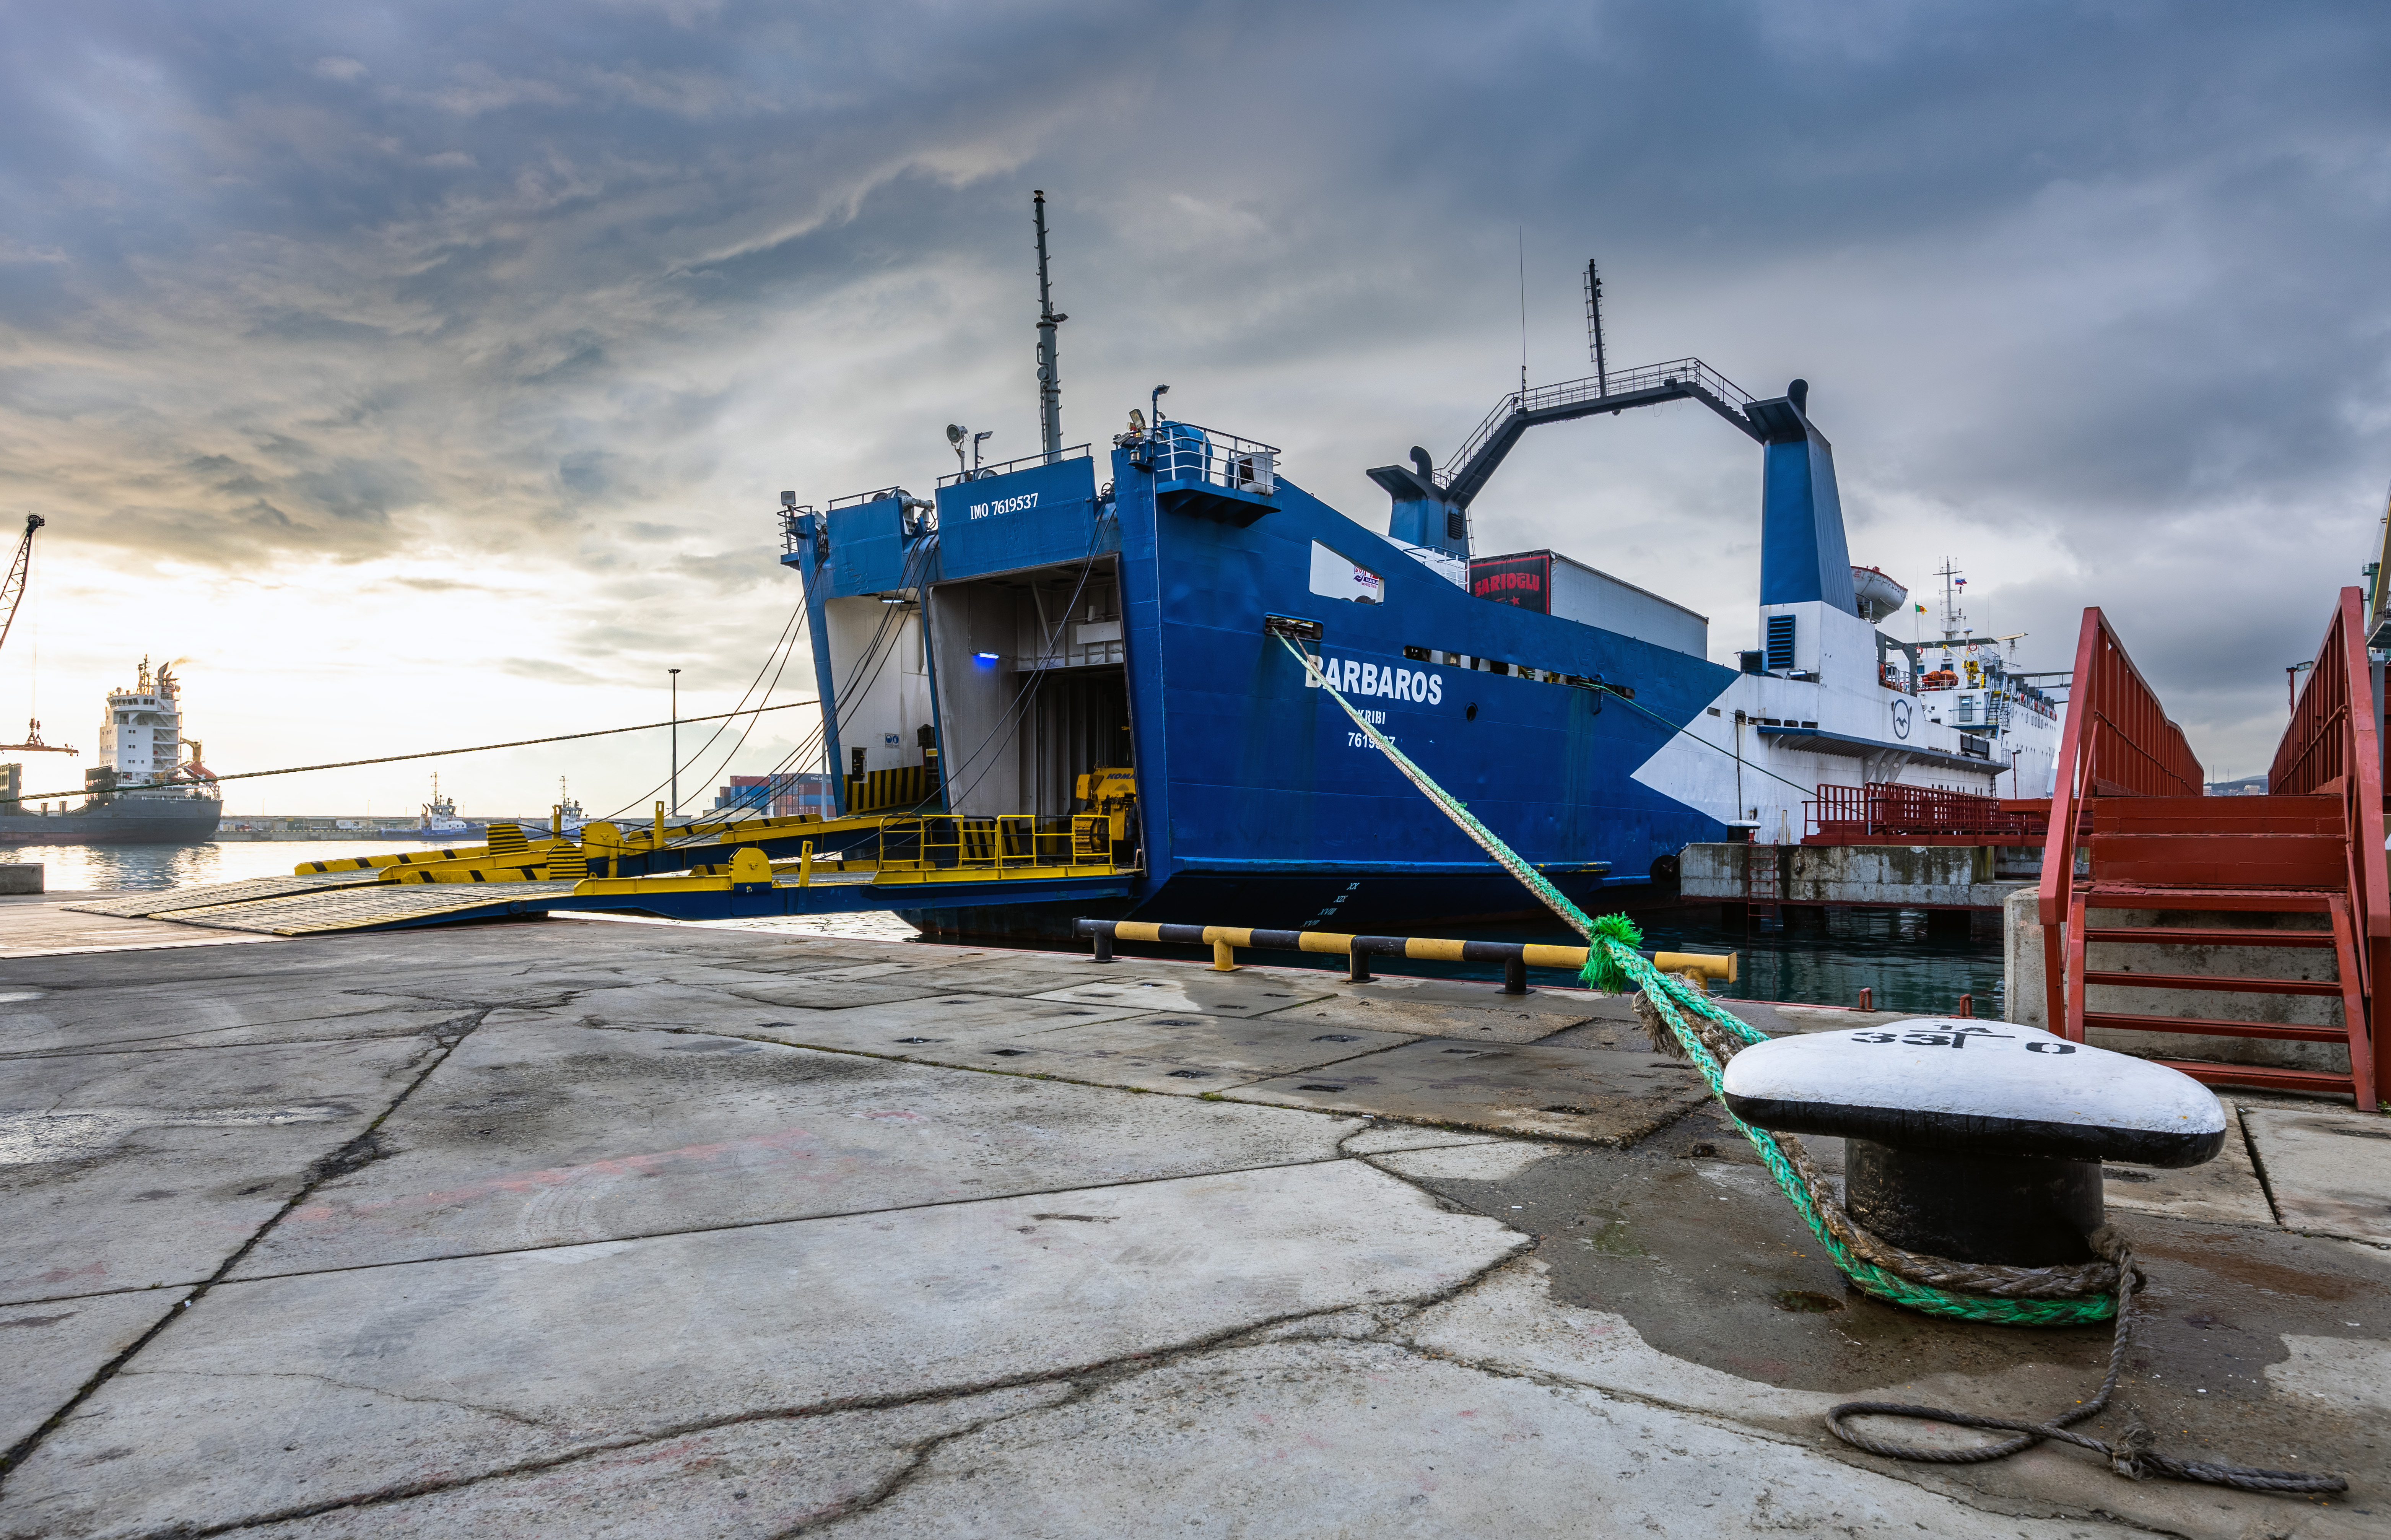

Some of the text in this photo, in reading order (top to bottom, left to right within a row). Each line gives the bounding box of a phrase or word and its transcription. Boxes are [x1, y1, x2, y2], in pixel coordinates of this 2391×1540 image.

[970, 493, 1038, 520] IMO 7619537
[1305, 654, 1442, 705] BARBAROS
[1348, 732, 1396, 750] 76197
[1300, 920, 1320, 928] XVII
